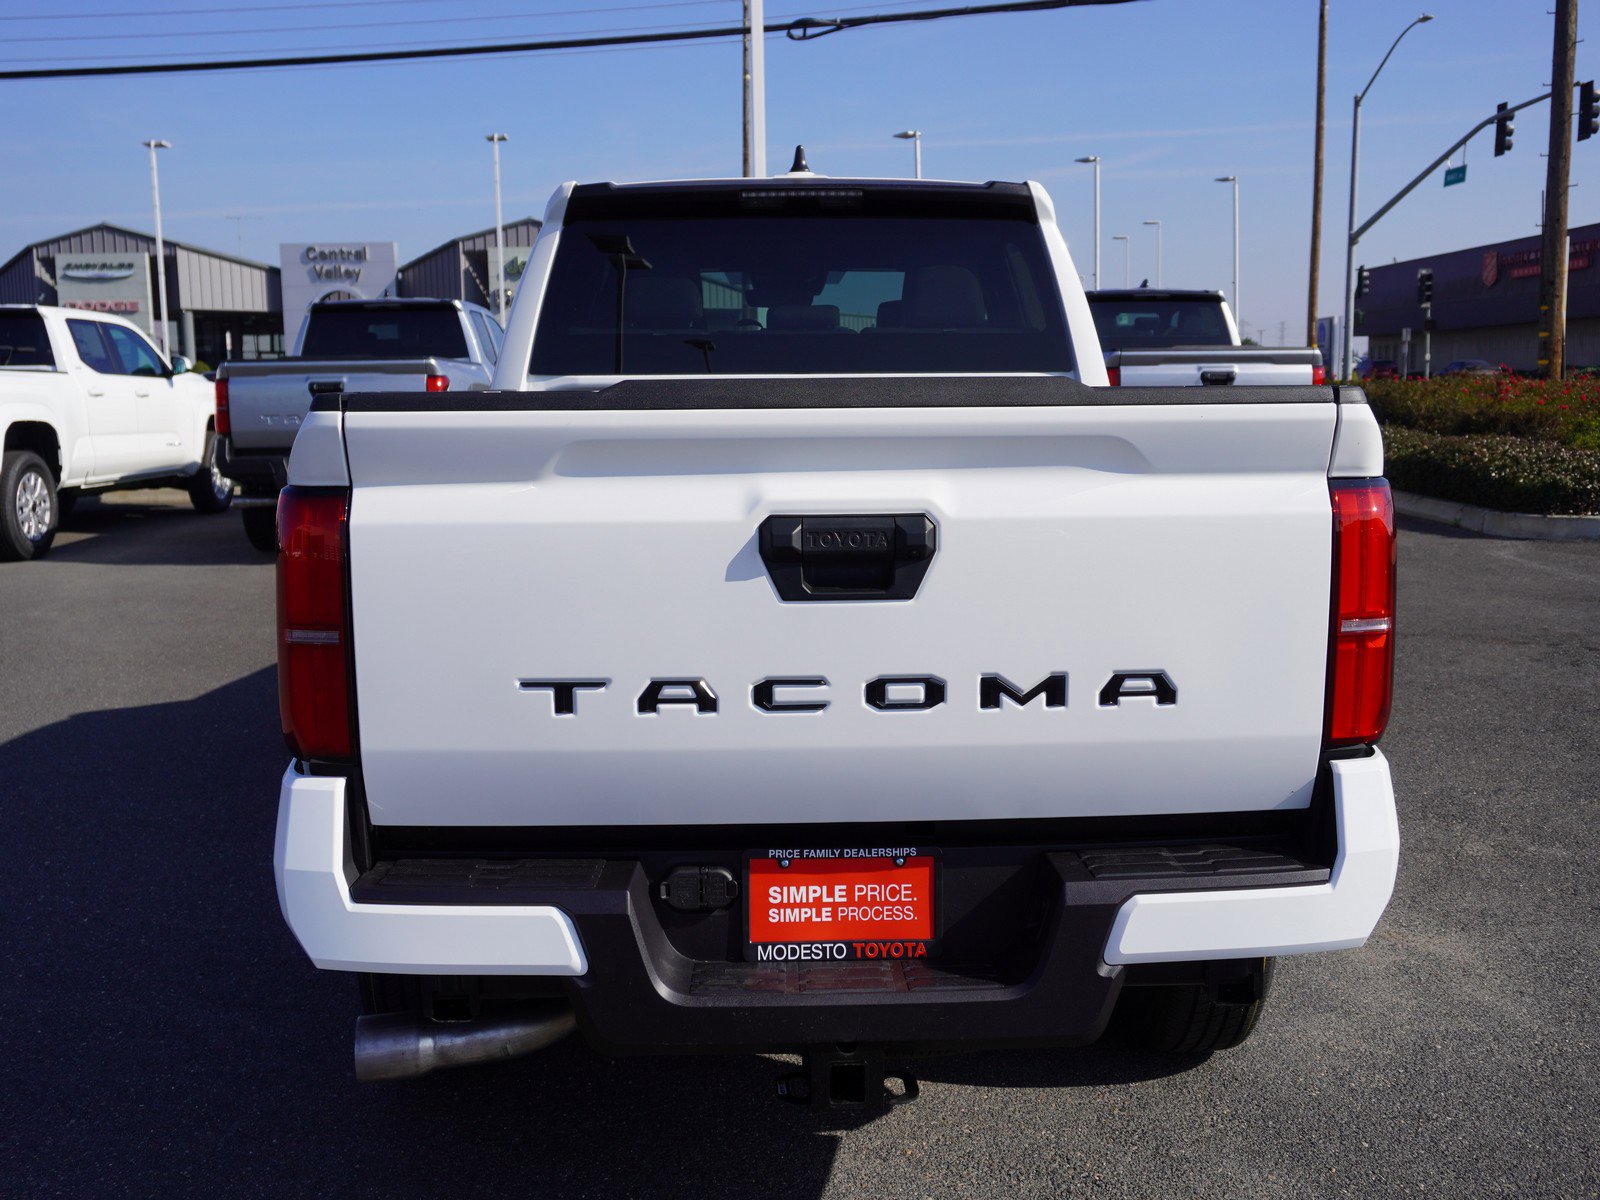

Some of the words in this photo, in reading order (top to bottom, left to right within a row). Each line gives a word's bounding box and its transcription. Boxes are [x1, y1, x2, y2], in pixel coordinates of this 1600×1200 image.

[305, 246, 367, 261] Central
[313, 264, 362, 282] Valley
[806, 531, 888, 548] TOYOTA
[516, 670, 1178, 718] TACOMA
[768, 849, 800, 859] PRICE
[803, 848, 841, 858] FAMILY
[844, 847, 917, 858] DEALERSHIPS
[768, 885, 847, 904] SIMPLE
[854, 884, 918, 902] PRICE.
[768, 907, 832, 923] SIMPLE
[838, 906, 918, 921] PROCESS.
[757, 943, 847, 961] MODESTO
[853, 942, 927, 959] TOYOTA
